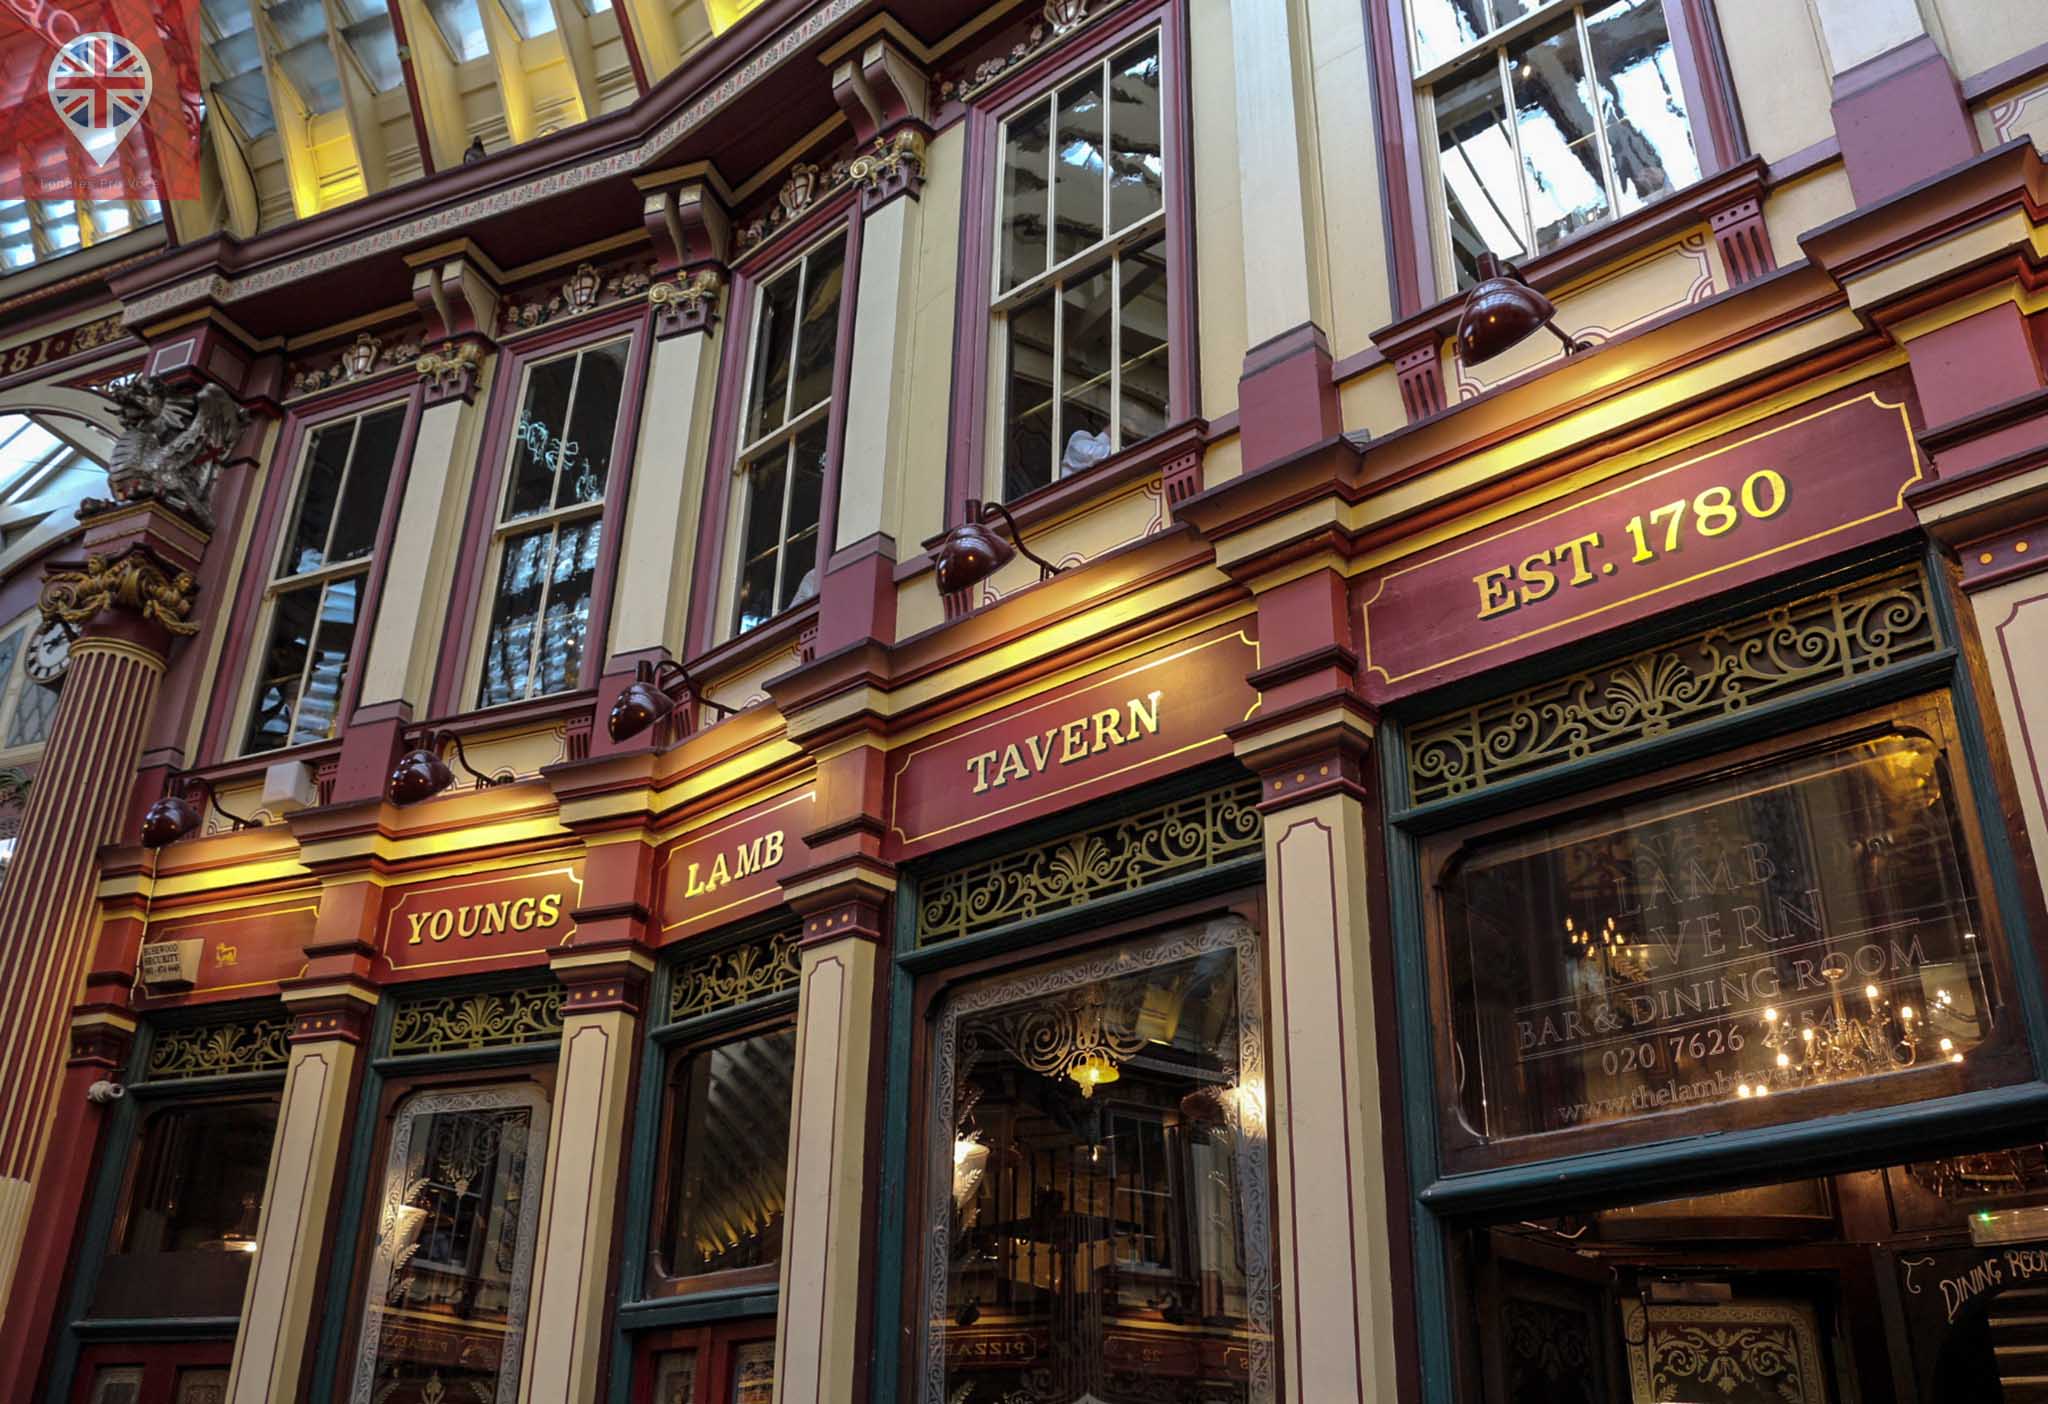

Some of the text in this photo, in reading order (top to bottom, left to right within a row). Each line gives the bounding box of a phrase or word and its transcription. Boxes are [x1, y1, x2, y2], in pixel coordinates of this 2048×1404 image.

[1472, 469, 1788, 620] EST. 1780
[967, 691, 1162, 795] TAVERN
[684, 830, 785, 899] LAMB
[1611, 842, 1777, 918] LAMB
[407, 893, 562, 945] YOUNGS
[1517, 934, 1930, 1050] BAR & DINING ROOM
[1602, 1043, 1656, 1076] 020
[1669, 1024, 1746, 1064] 7626
[1939, 1257, 2002, 1325] DINING
